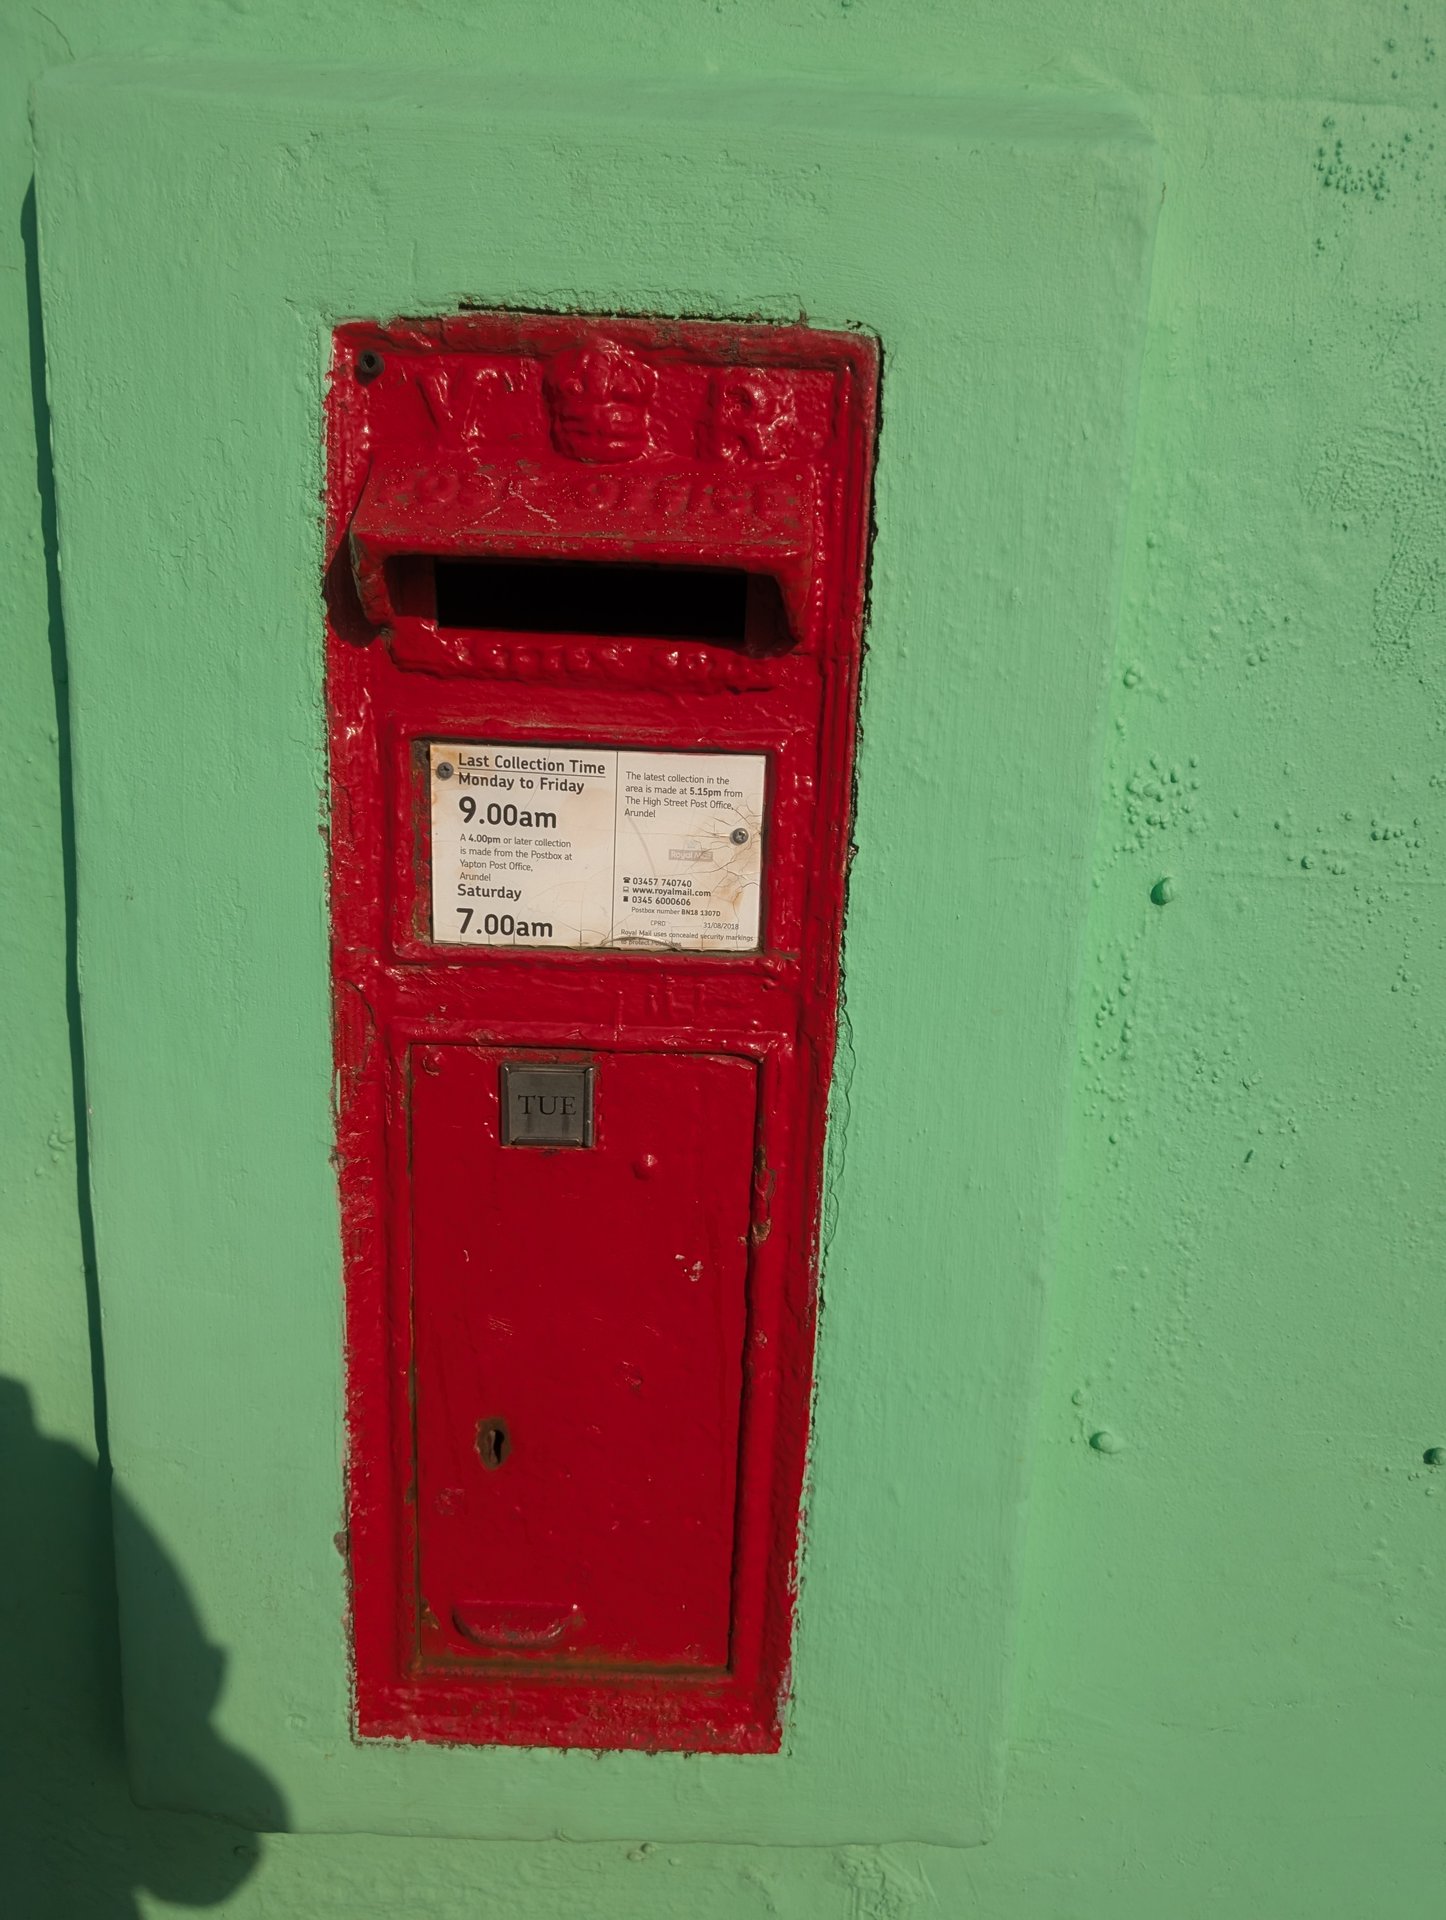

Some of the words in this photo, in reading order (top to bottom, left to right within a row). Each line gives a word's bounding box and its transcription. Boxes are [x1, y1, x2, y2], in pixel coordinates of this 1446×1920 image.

[459, 753, 490, 767] Last
[495, 755, 564, 772] Collection
[569, 760, 605, 774] Time
[459, 772, 514, 790] Monday
[520, 777, 533, 789] to
[540, 777, 584, 794] Friday
[626, 771, 641, 780] The
[643, 773, 665, 782] latest
[667, 774, 704, 784] collection
[707, 776, 714, 784] in
[716, 777, 729, 785] the
[625, 785, 643, 793] area
[646, 785, 652, 793] is
[654, 786, 677, 794] made
[679, 787, 687, 795] at
[689, 787, 721, 797] 5.15pm
[723, 789, 743, 798] from
[625, 796, 640, 805] The
[643, 797, 662, 807] High
[663, 798, 688, 807] Street
[690, 799, 707, 808] Post
[710, 800, 734, 810] Office,
[459, 796, 557, 829] 9.00am
[624, 808, 656, 818] Arundel
[460, 834, 466, 842] A
[468, 834, 500, 844] 4.00pm
[514, 836, 532, 846] later
[534, 838, 571, 848] collection
[460, 847, 467, 855] is
[469, 848, 491, 856] made
[494, 849, 513, 858] from
[516, 850, 529, 858] the
[531, 850, 562, 860] Postbox
[564, 853, 572, 861] at
[460, 859, 486, 870] Yapton
[490, 860, 507, 870] Post
[509, 862, 533, 872] Office,
[459, 872, 491, 881] Arundel
[632, 877, 658, 886] 03457
[661, 879, 692, 888] 740740
[457, 884, 522, 901] Saturday
[632, 887, 711, 897] www.royalmail.com
[632, 896, 652, 904] 0345
[655, 897, 691, 906] 6000606
[456, 907, 553, 938] 7.00am
[703, 922, 739, 930] 31/08/2018
[620, 929, 637, 937] Royal
[700, 934, 724, 942] security
[726, 935, 754, 943] markings
[518, 1094, 577, 1116] TUE
